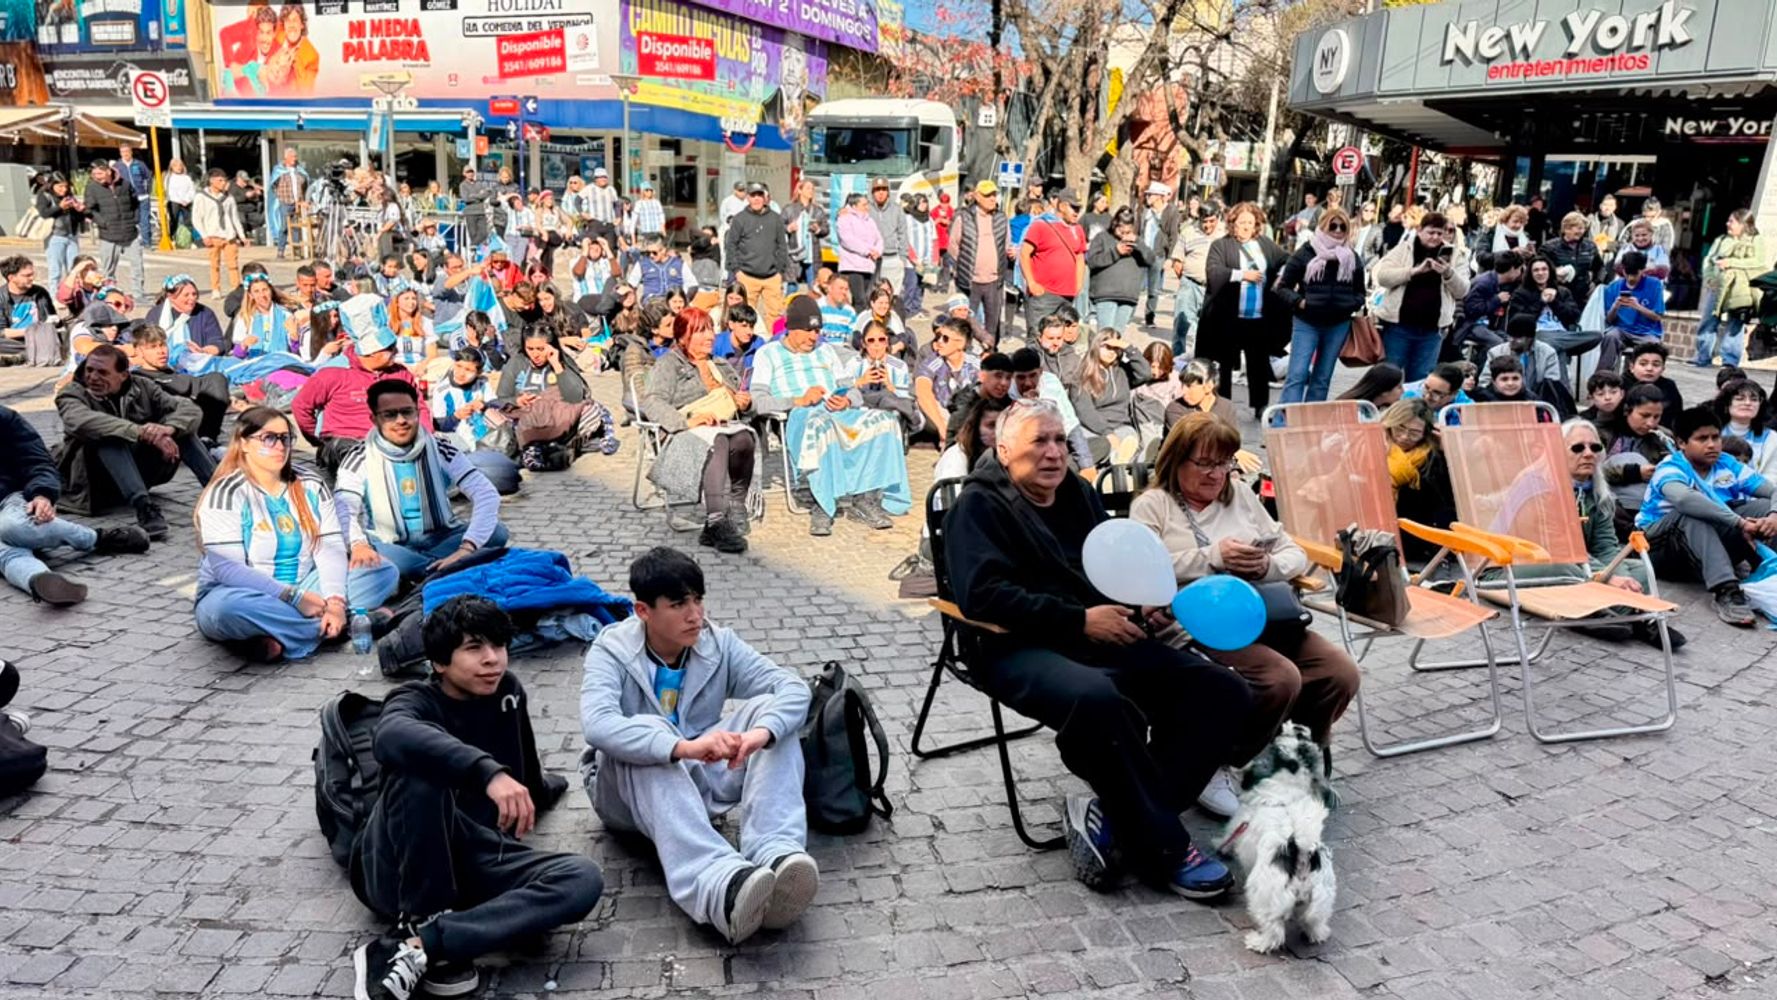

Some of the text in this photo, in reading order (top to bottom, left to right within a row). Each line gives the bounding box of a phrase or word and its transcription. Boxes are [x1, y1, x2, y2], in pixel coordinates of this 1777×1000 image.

[801, 4, 871, 40] DOMINGOS
[858, 5, 868, 19] A
[349, 18, 422, 39] NI MEDIA
[482, 21, 523, 32] COMEDIA
[527, 21, 543, 31] DEL
[1442, 1, 1695, 63] New York
[342, 39, 430, 63] PALABRA
[501, 35, 562, 55] Disponible
[641, 35, 712, 60] Disponible
[1319, 46, 1338, 70] NY
[1488, 54, 1649, 79] entretenimientos
[1664, 117, 1718, 135] New
